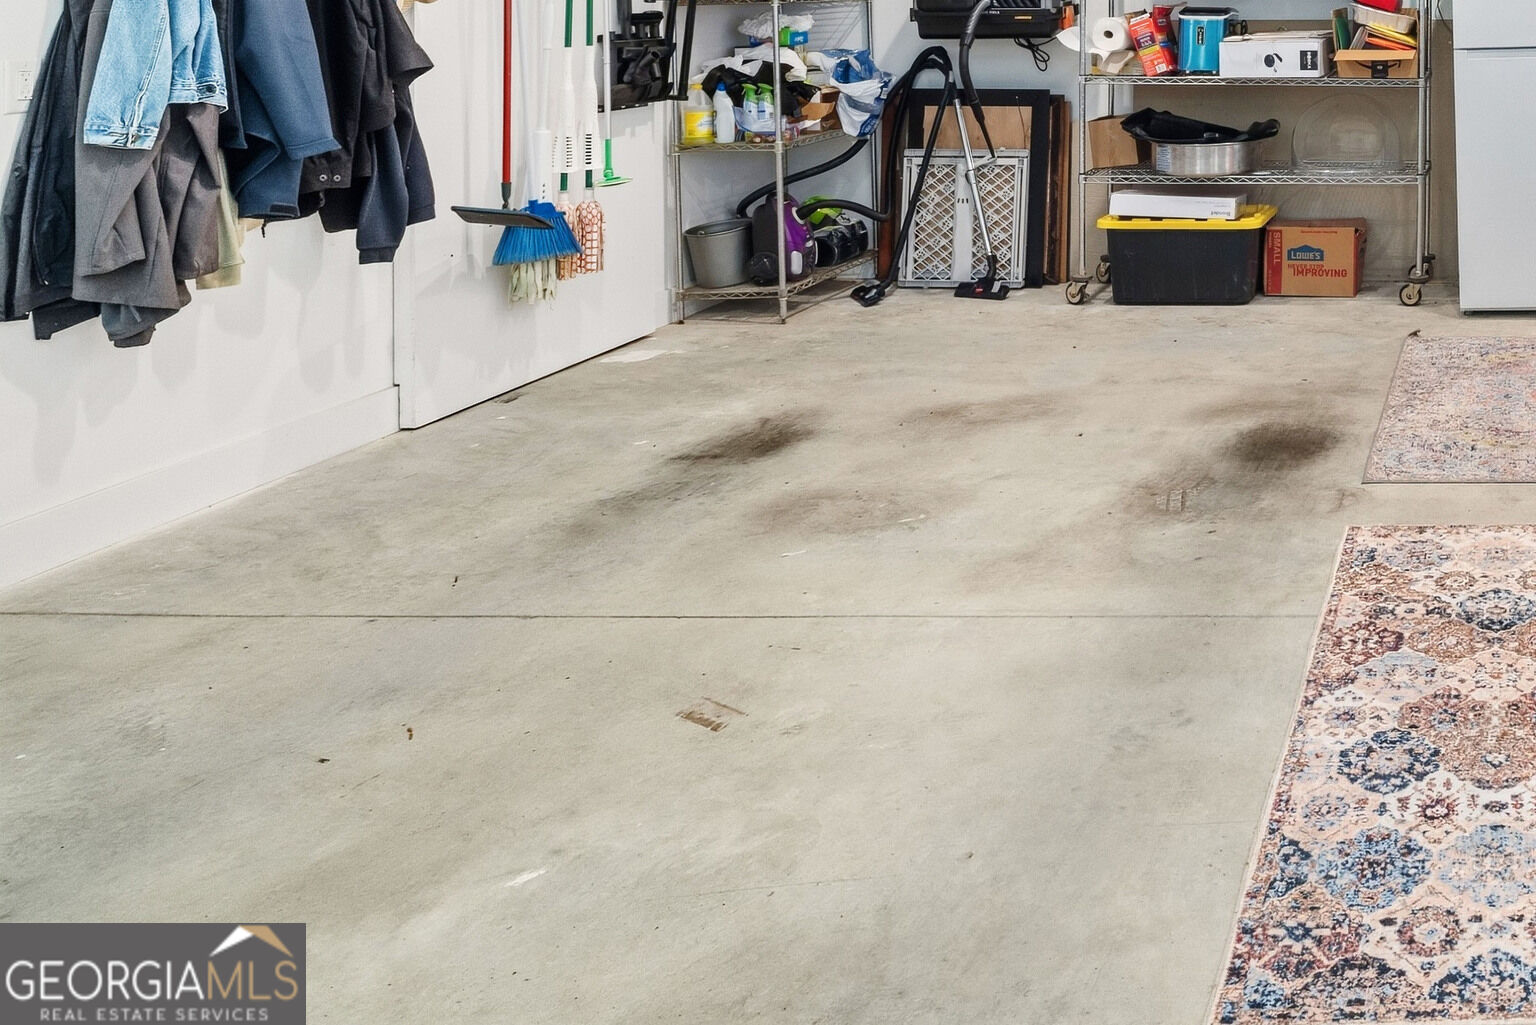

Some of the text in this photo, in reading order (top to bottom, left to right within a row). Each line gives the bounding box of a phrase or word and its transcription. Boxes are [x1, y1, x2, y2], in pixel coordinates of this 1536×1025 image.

[1273, 231, 1281, 264] SMALL
[1290, 250, 1321, 260] LOWE'S
[1293, 268, 1348, 278] IMPROVING
